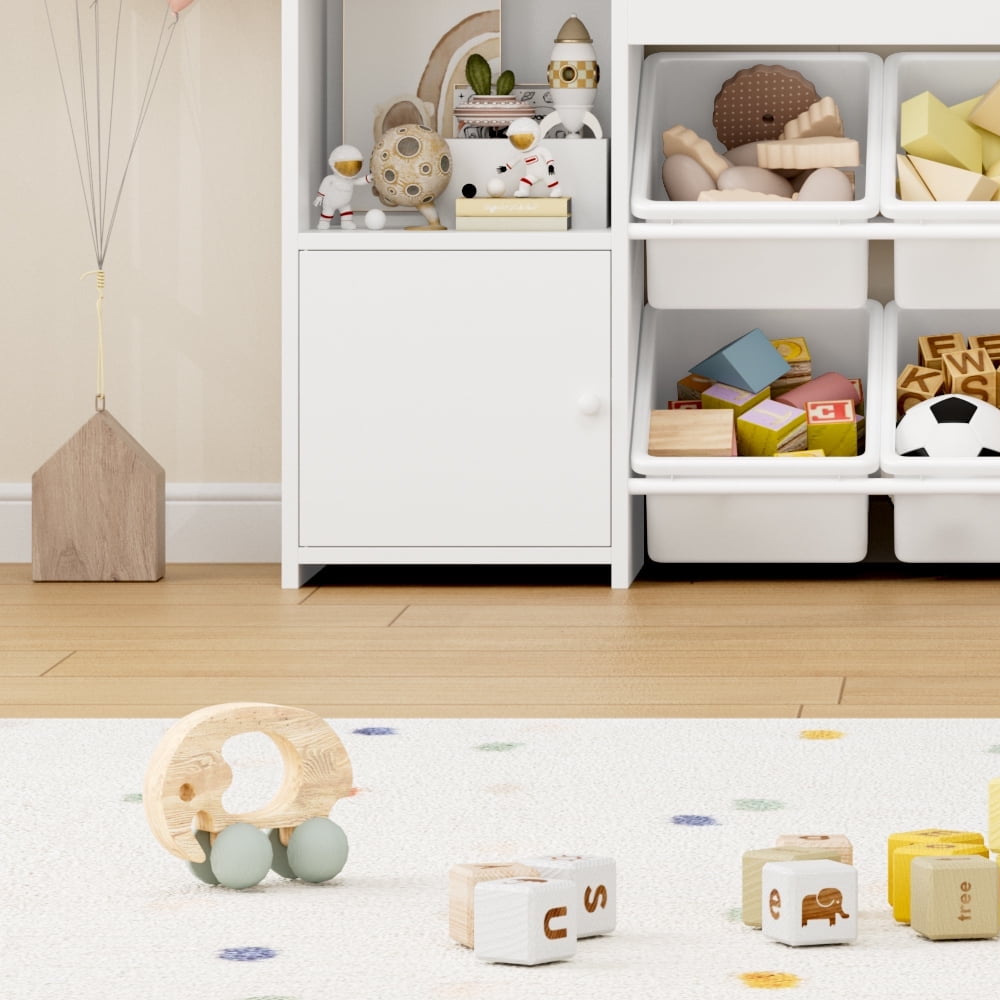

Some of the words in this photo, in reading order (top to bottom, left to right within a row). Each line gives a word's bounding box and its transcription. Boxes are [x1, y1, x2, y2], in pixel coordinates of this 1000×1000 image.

[927, 335, 955, 358] E
[946, 350, 985, 375] W
[901, 367, 941, 392] K
[958, 880, 972, 921] tree
